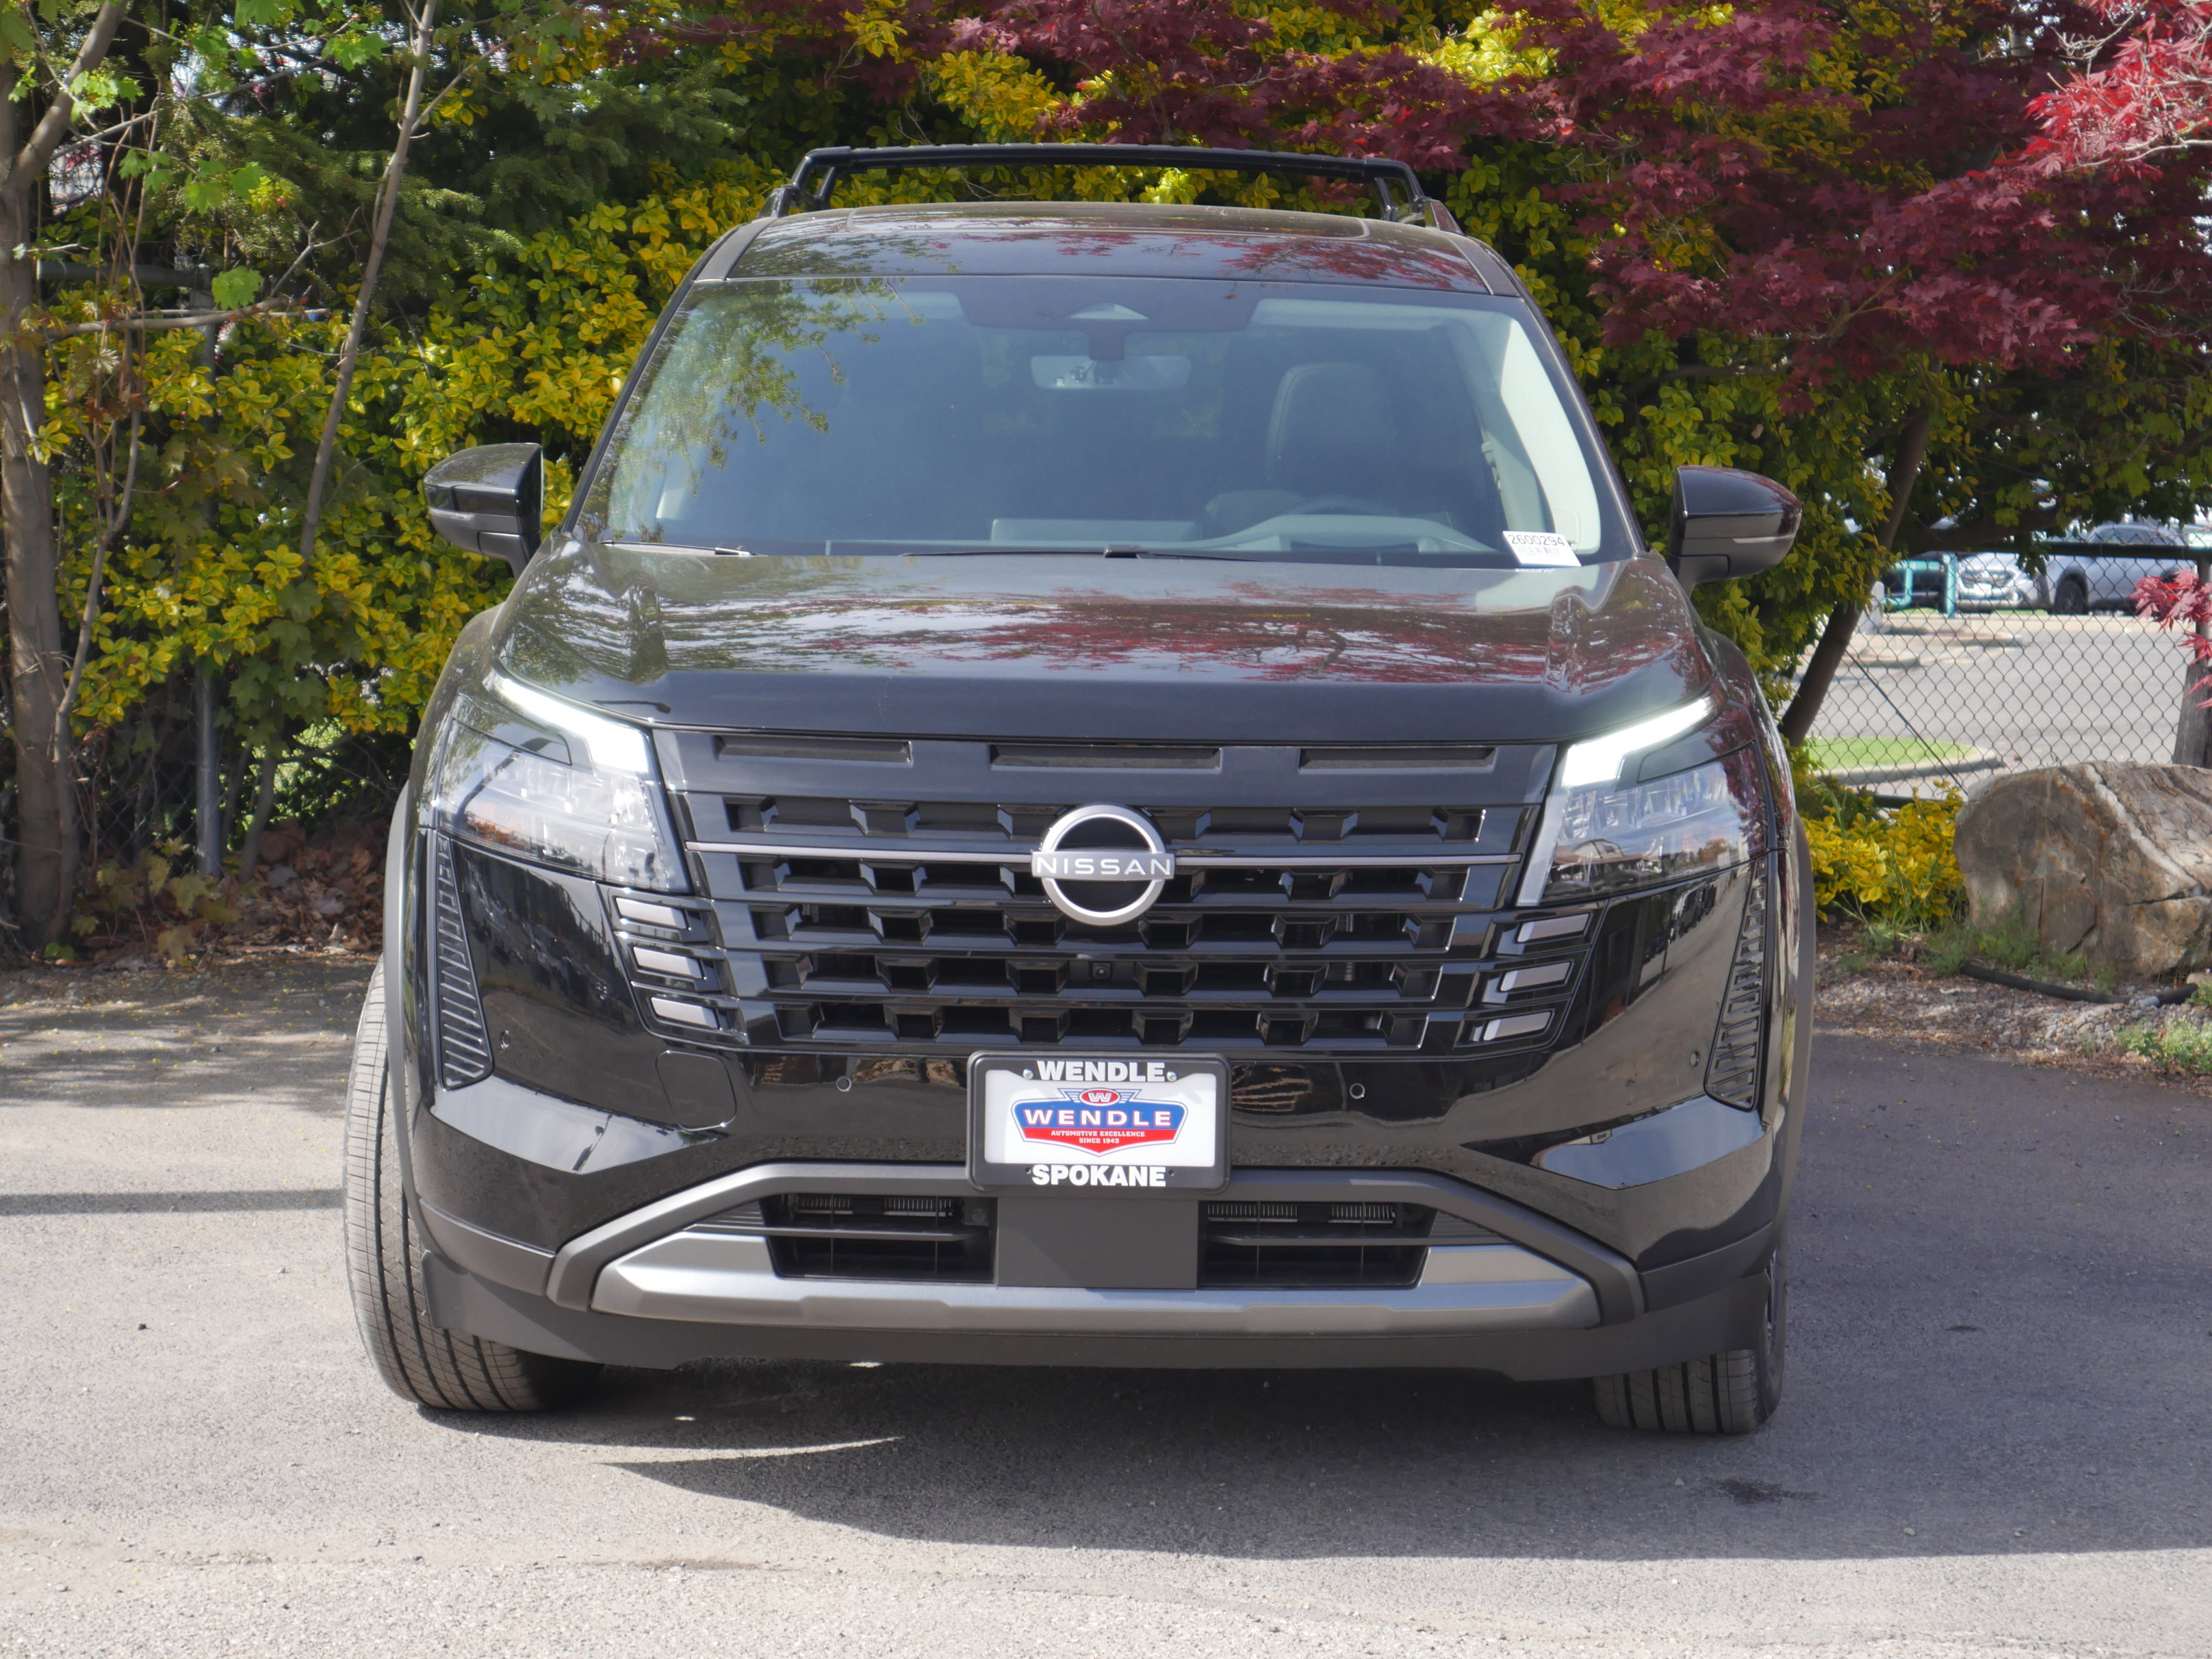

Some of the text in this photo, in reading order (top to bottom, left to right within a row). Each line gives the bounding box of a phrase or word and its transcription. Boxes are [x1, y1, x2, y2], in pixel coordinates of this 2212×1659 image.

[1508, 535, 1565, 546] 2600294
[1036, 856, 1171, 875] NISSAN
[1037, 1060, 1166, 1082] WENDLE
[1024, 1109, 1172, 1127] WENDLE
[1031, 1164, 1166, 1187] SPOKANE
